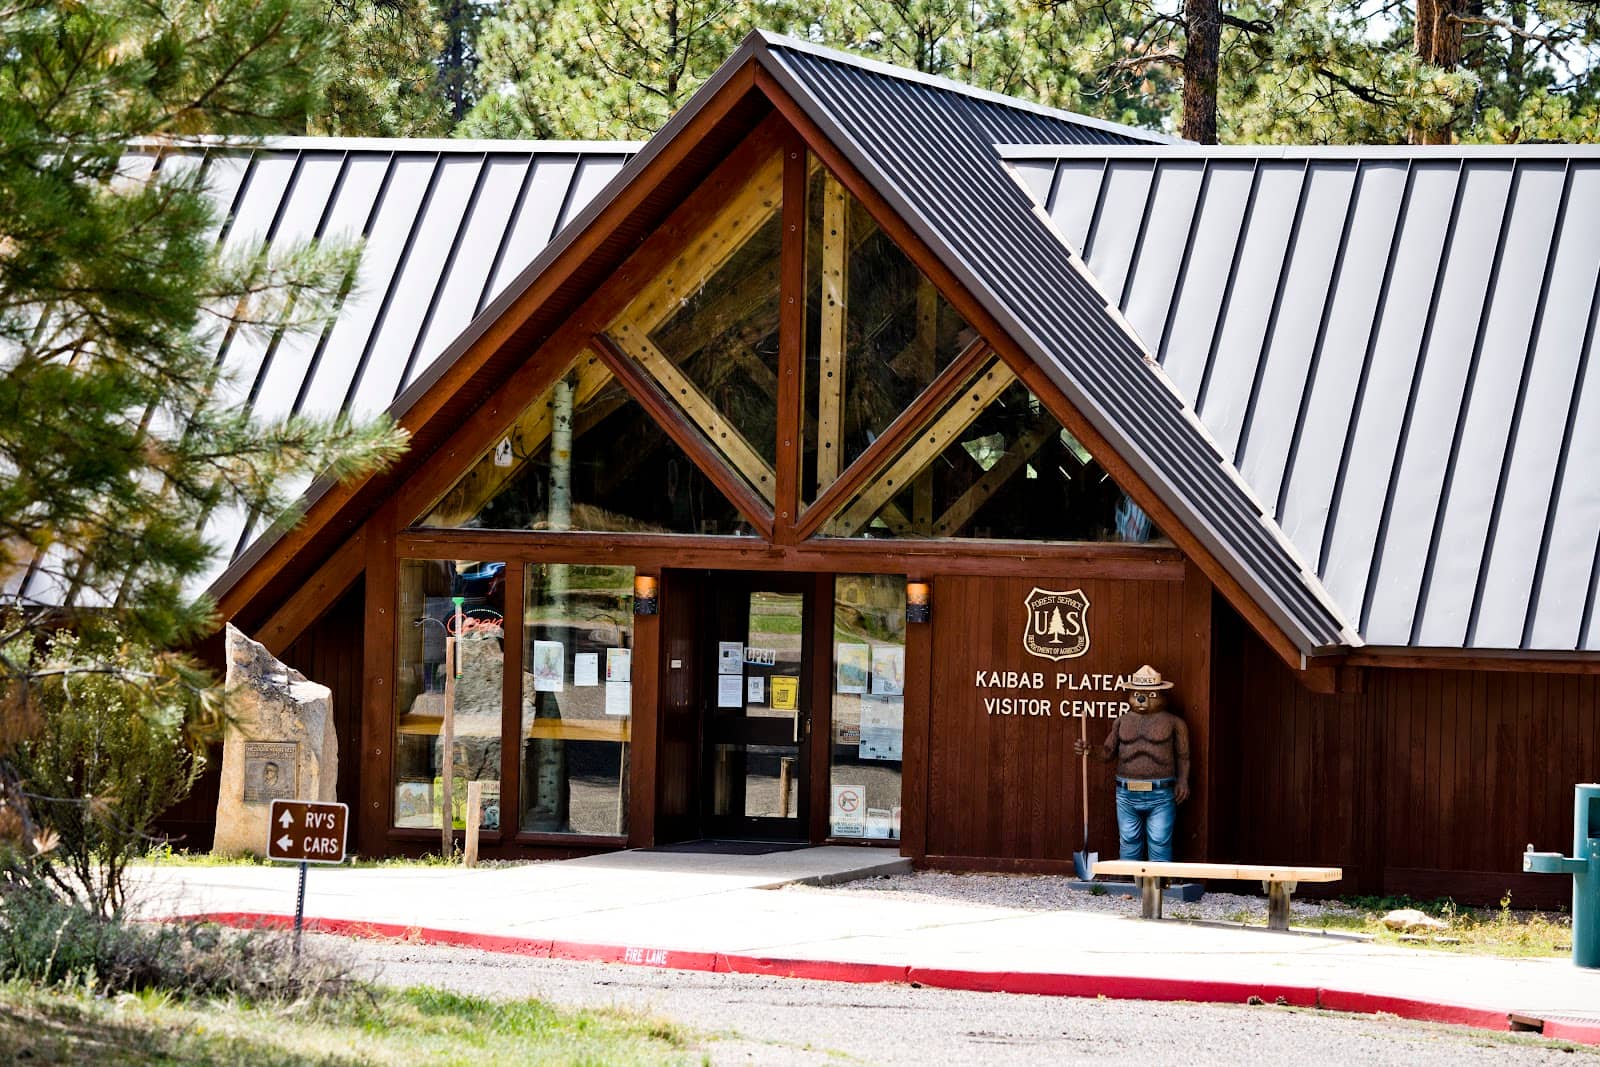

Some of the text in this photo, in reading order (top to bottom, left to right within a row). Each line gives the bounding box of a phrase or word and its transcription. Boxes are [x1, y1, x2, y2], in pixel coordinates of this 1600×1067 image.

[1031, 595, 1084, 611] FOREST SERVICE
[746, 648, 775, 664] OPEN
[975, 670, 1044, 690] KAIBAB
[984, 697, 1131, 719] VISITOR CENTER
[305, 812, 336, 830] RV'S
[303, 836, 339, 855] CARS
[624, 947, 668, 965] FIRE LANE
